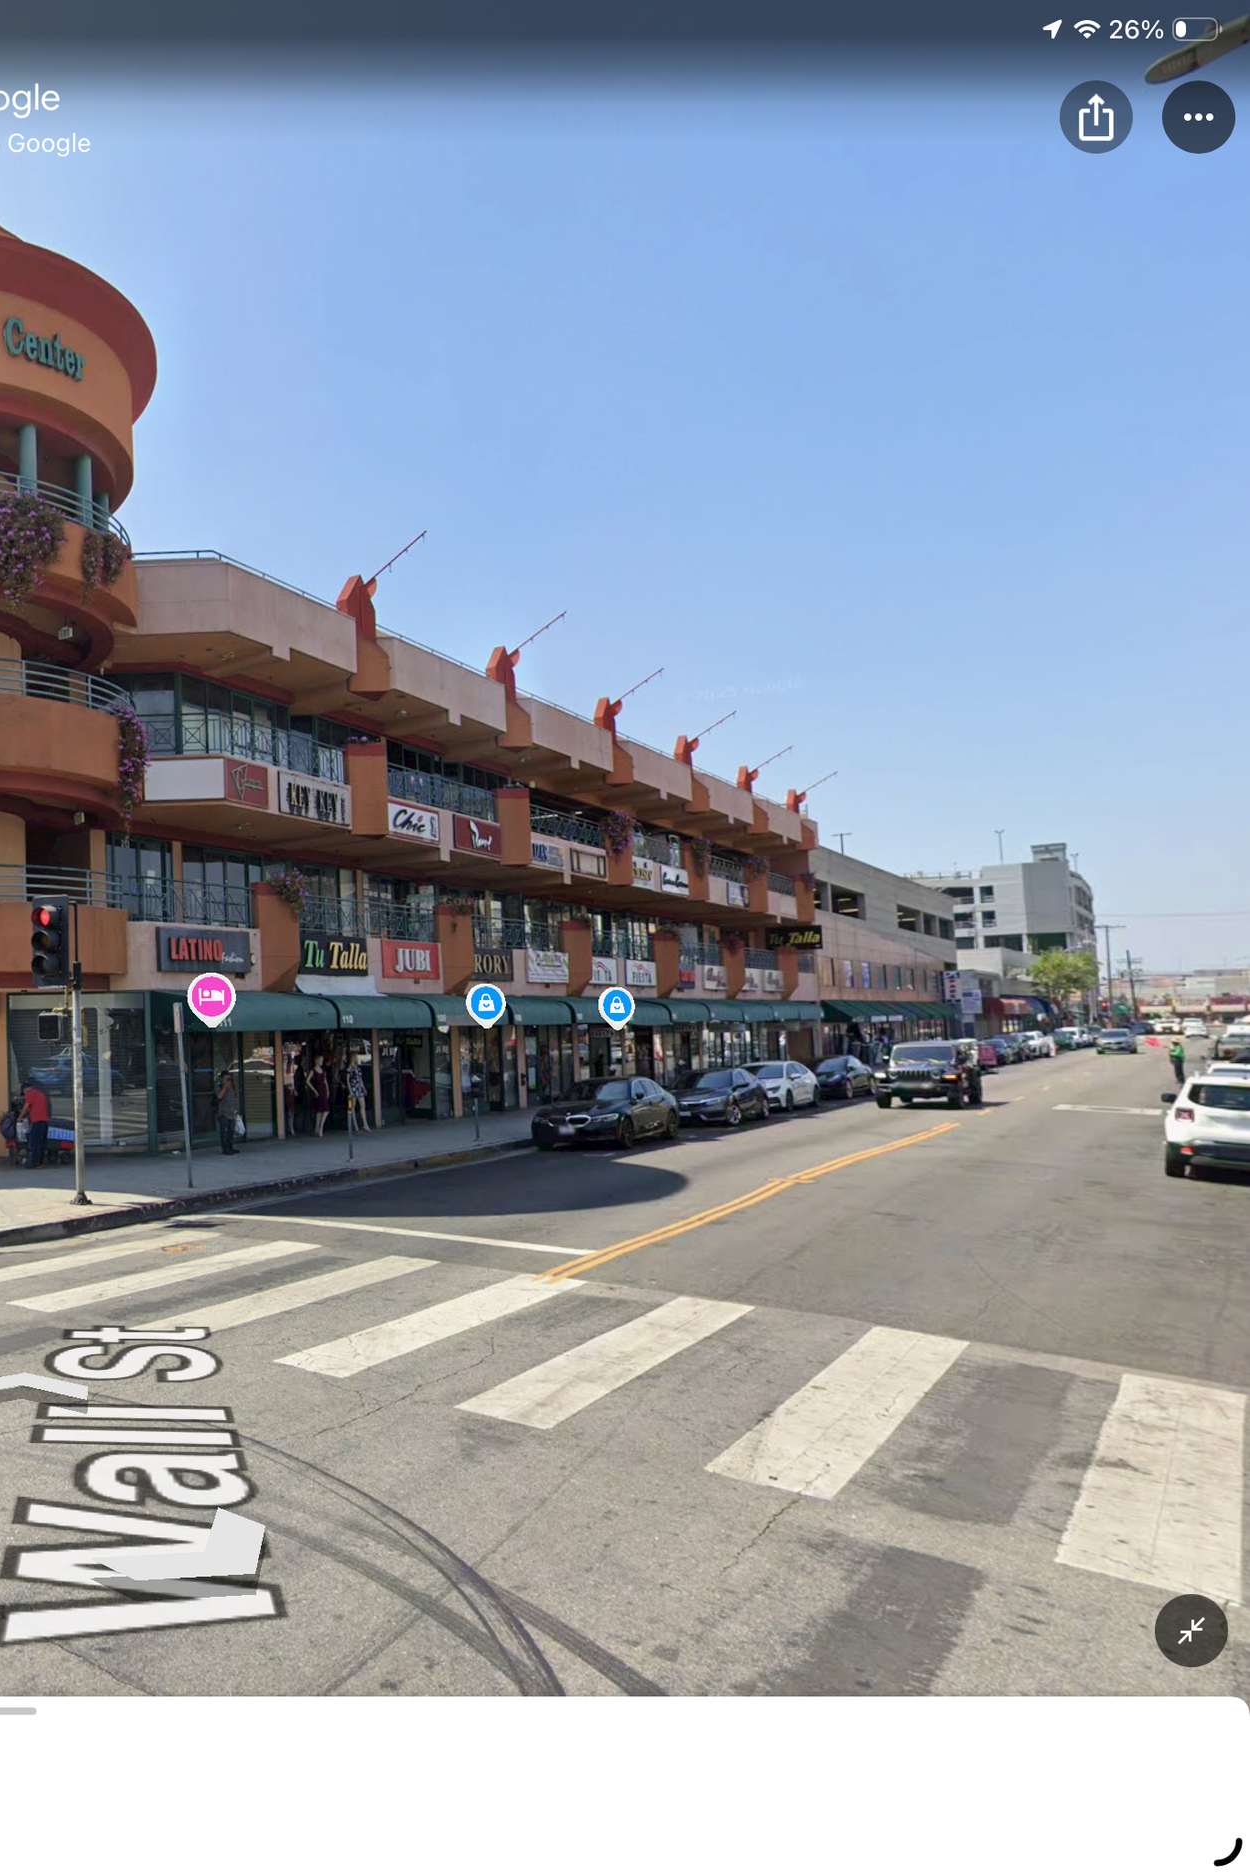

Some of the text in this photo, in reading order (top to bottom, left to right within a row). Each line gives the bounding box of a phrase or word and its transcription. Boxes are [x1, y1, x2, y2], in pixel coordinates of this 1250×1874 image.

[4, 316, 86, 383] Center
[393, 809, 427, 833] Chic
[170, 937, 224, 962] LATINO
[788, 931, 821, 945] Talla
[303, 940, 367, 970] Tu Talla
[394, 948, 432, 973] JUBI
[474, 958, 511, 976] RORY
